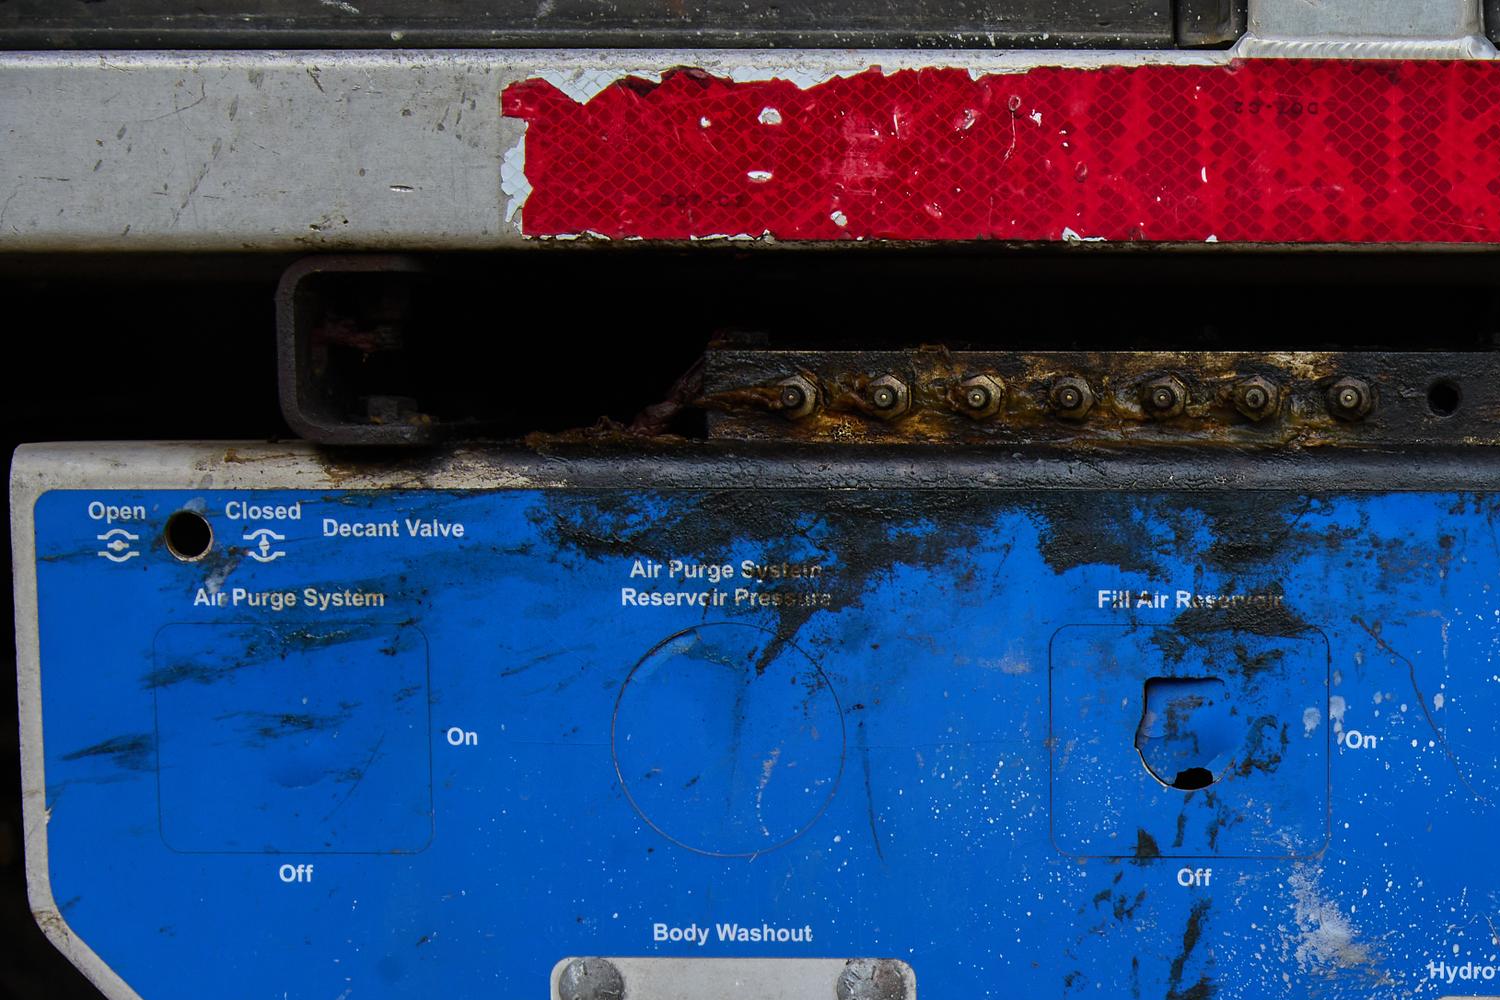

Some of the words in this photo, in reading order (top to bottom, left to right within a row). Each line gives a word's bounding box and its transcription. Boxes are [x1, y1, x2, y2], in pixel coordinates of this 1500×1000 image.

[89, 502, 145, 523] Open
[226, 502, 300, 519] Closed
[324, 519, 397, 536] Decant
[406, 520, 464, 537] Valve
[628, 560, 662, 579] Air
[669, 560, 734, 582] Purge
[193, 588, 226, 606] Air
[233, 589, 295, 610] Purge
[304, 589, 384, 610] System
[621, 588, 727, 606] Reservoir
[1098, 590, 1131, 608] Fill
[1136, 590, 1169, 608] Air
[448, 728, 477, 745] On
[1346, 731, 1376, 748] On
[280, 865, 313, 881] Off
[1178, 868, 1211, 886] Off
[654, 924, 709, 945] Body
[714, 923, 812, 941] Washout
[1431, 962, 1496, 984] Hydro
